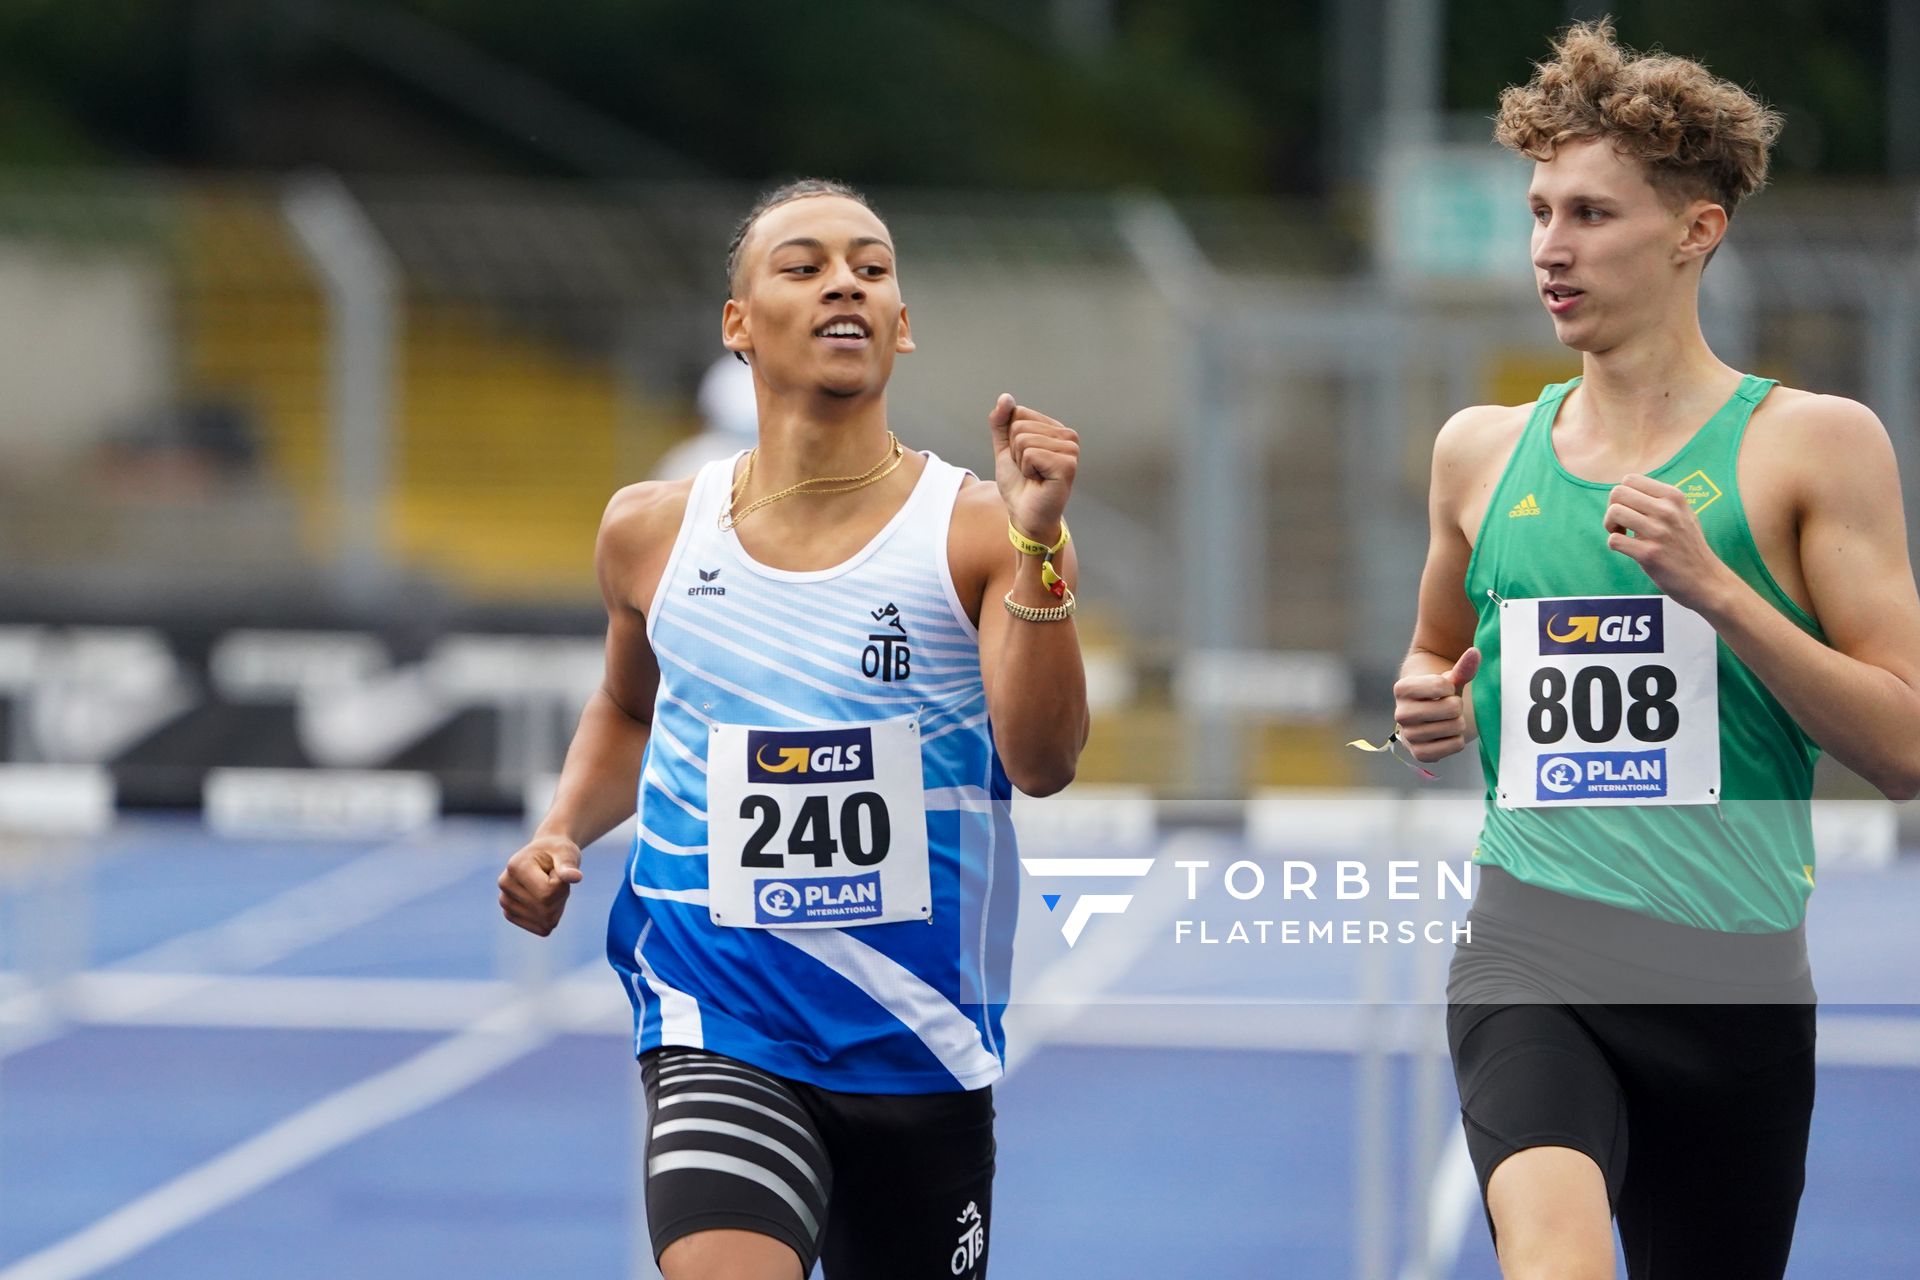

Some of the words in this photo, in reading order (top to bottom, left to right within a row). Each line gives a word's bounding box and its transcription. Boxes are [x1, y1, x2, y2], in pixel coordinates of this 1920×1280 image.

[687, 585, 726, 596] erima
[1599, 615, 1652, 643] GLS
[1527, 664, 1680, 745] 808
[810, 744, 862, 773] GLS
[1586, 759, 1661, 781] PLAN
[1587, 783, 1662, 792] INTERNATIONAL
[739, 791, 891, 869] 240
[804, 881, 877, 906] PLAN
[806, 904, 877, 917] INTERNATIONAL
